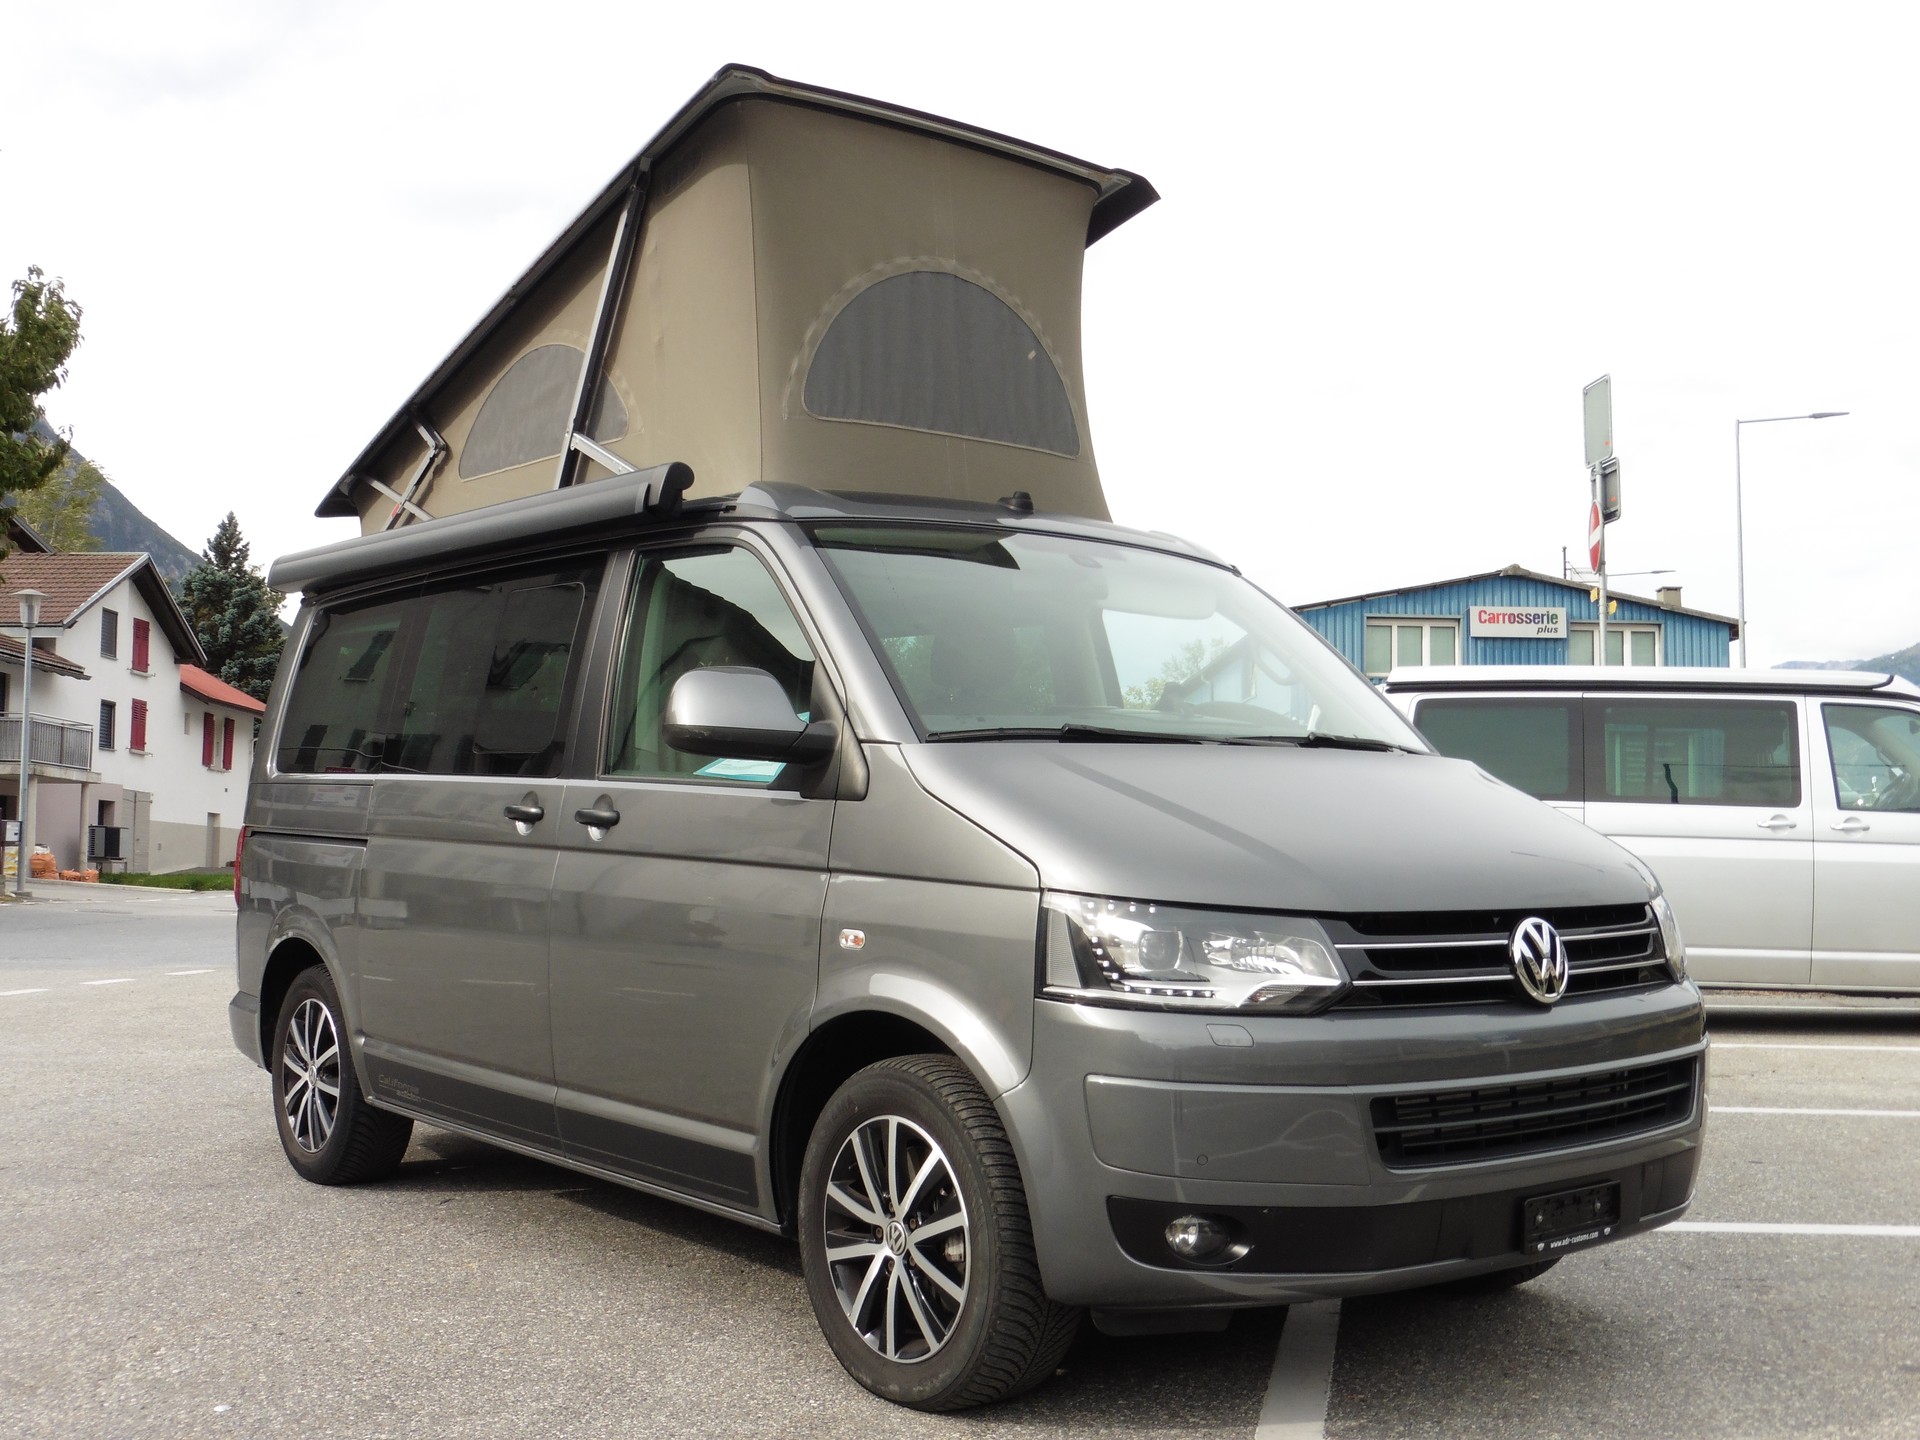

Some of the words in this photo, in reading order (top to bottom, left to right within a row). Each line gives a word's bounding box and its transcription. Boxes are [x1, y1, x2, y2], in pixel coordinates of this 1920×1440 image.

[1478, 609, 1559, 625] Carrosserie
[1536, 625, 1559, 635] plus
[1514, 917, 1568, 1003] VW
